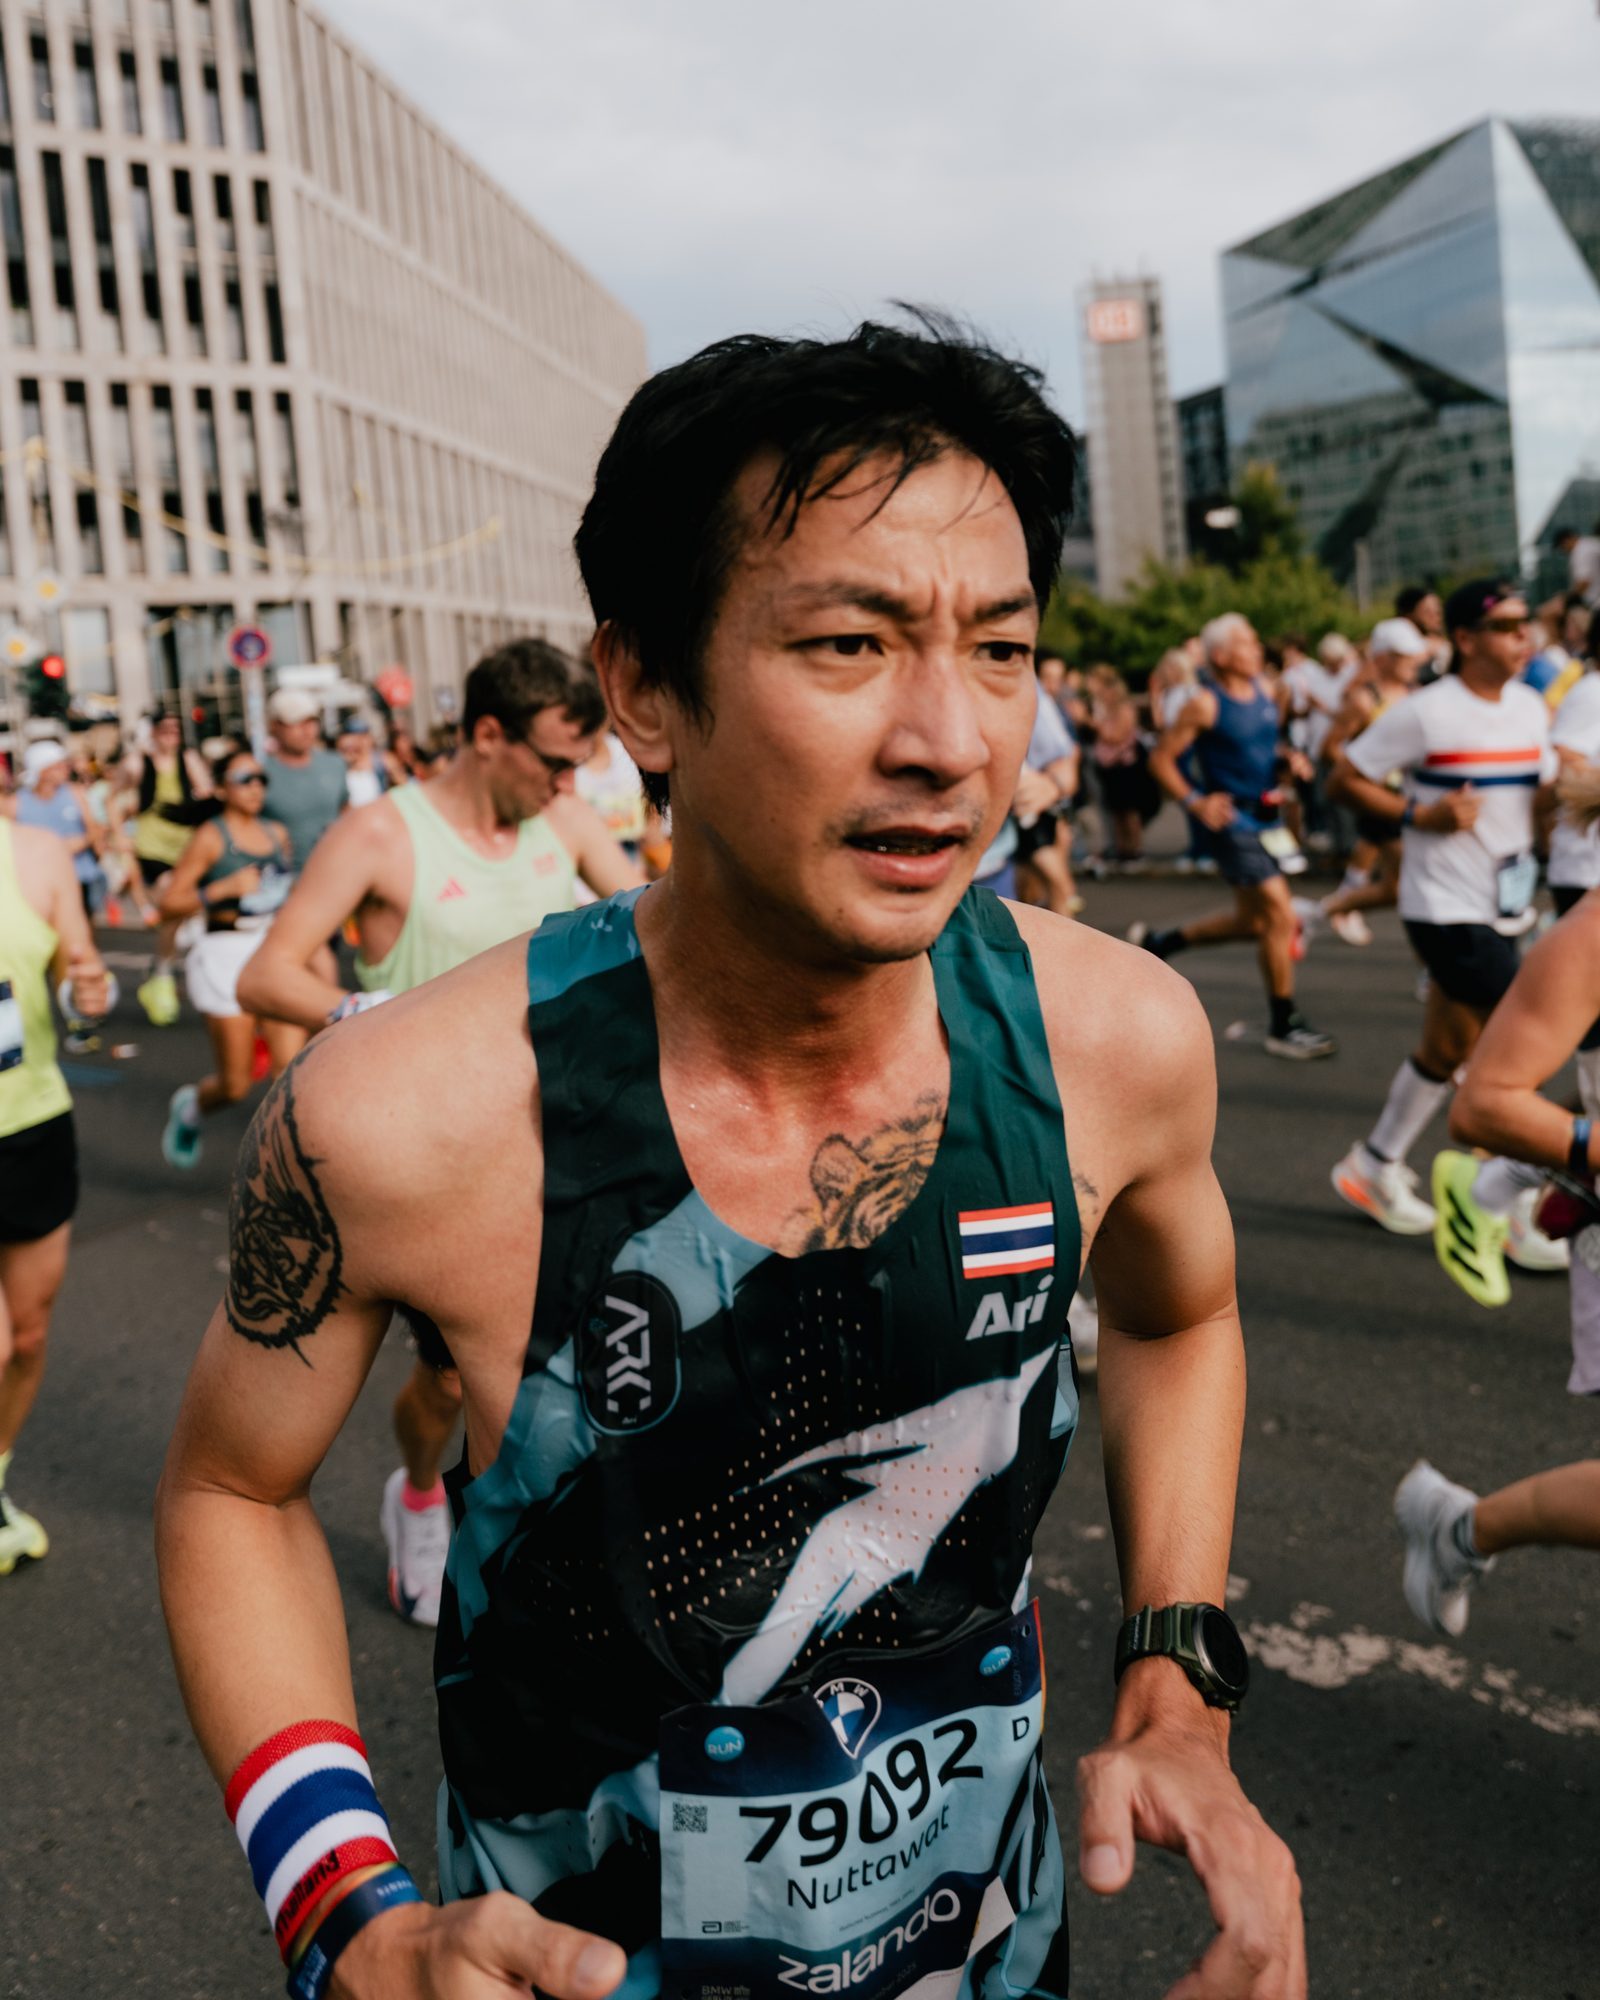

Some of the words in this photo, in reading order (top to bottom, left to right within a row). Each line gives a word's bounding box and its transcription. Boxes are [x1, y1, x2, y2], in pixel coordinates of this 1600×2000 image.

[966, 1274, 1054, 1341] Ari
[708, 1740, 742, 1754] RUN
[1012, 1716, 1029, 1741] D
[739, 1720, 983, 1866] 79092
[787, 1805, 949, 1909] Nuttawat
[777, 1888, 960, 1993] zalando
